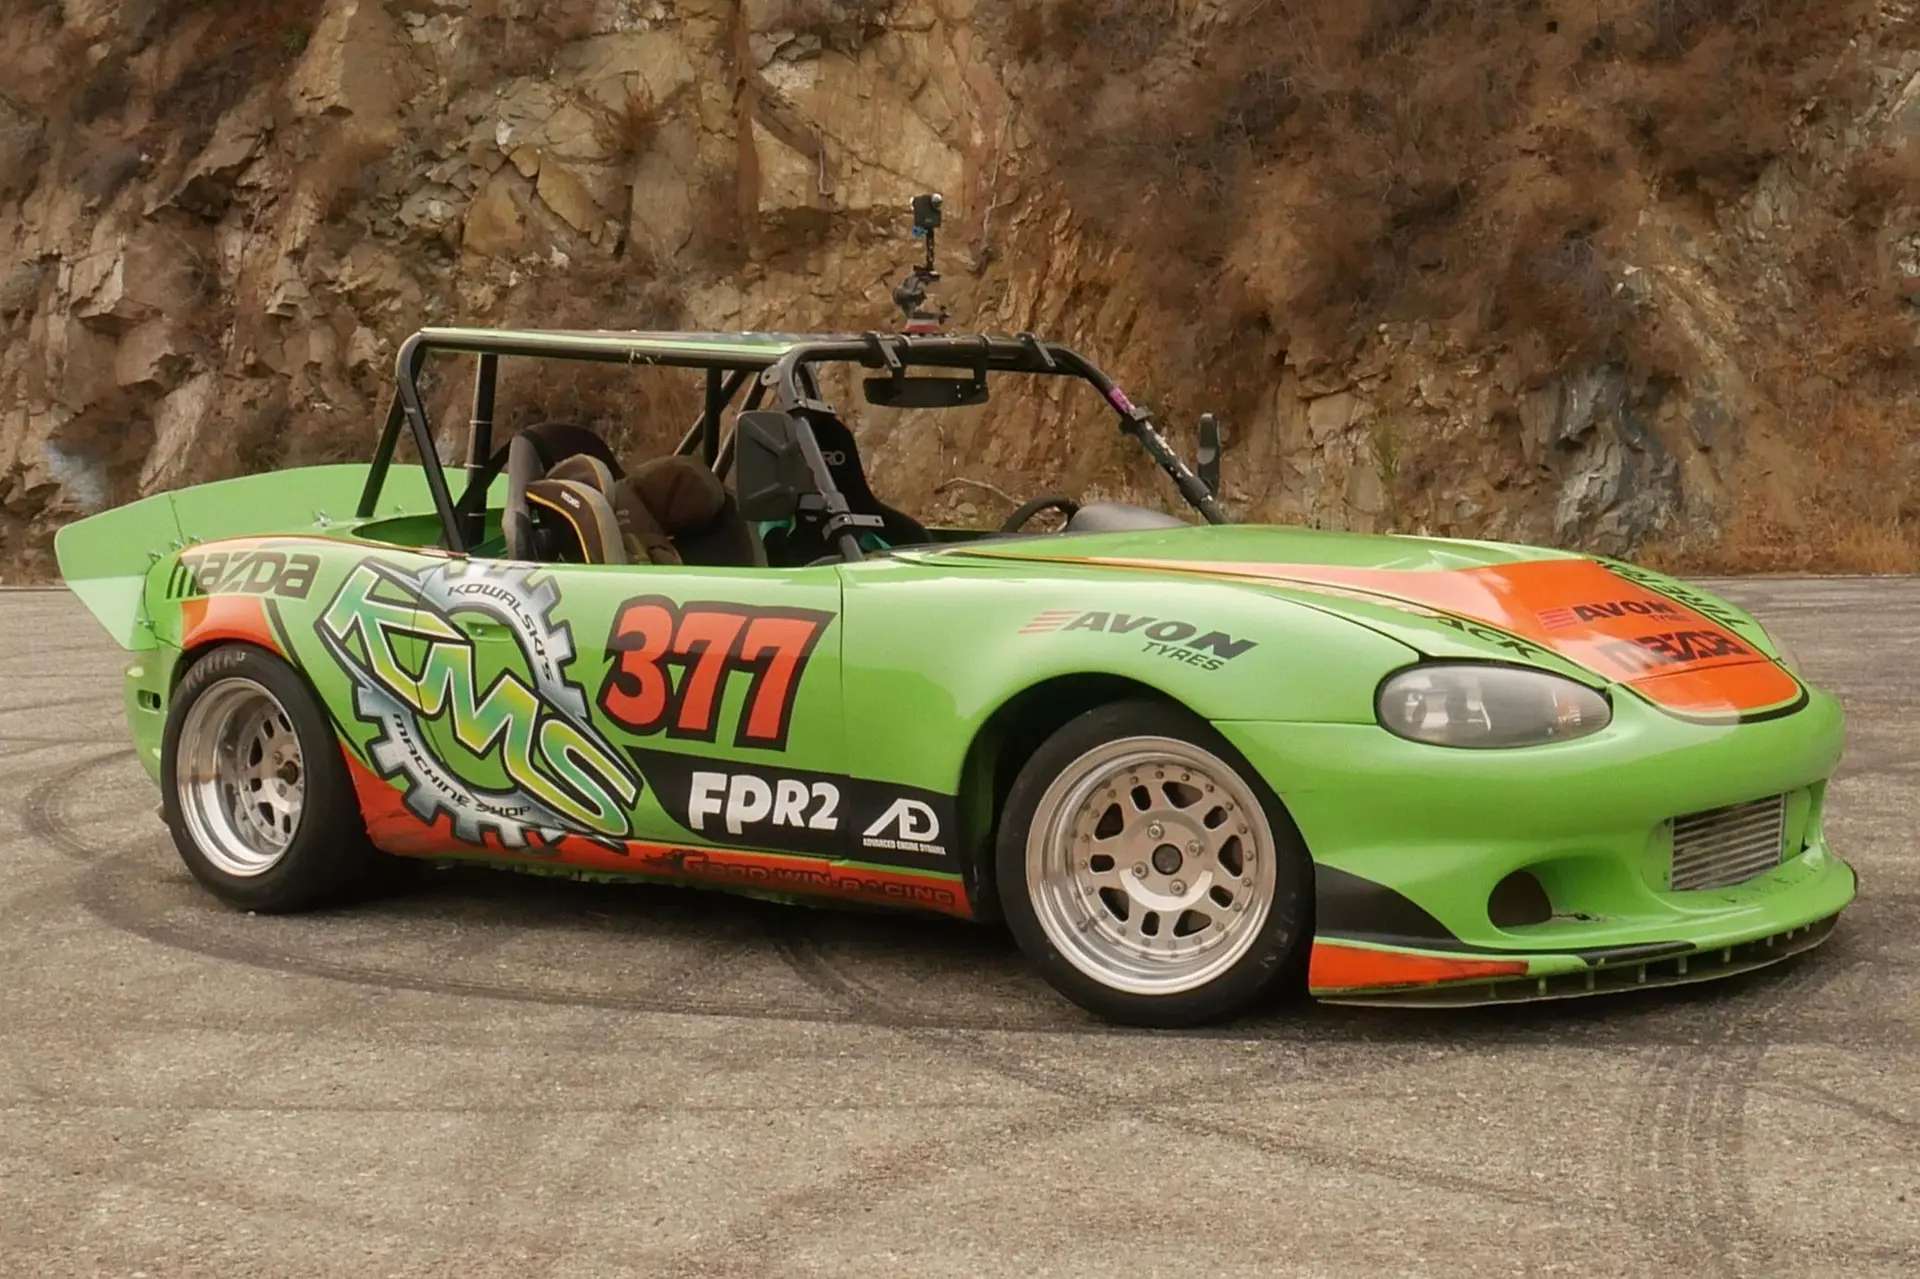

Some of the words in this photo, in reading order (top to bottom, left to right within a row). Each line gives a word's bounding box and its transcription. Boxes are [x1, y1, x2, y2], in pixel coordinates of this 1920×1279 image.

[1061, 611, 1259, 660] AVON
[1573, 601, 1677, 622] AVON
[600, 598, 833, 748] 377
[1142, 641, 1224, 671] TYRES
[317, 560, 640, 840] KMS
[393, 713, 470, 807] MACHINE
[475, 802, 531, 818] SHOP
[688, 771, 840, 834] FPR2
